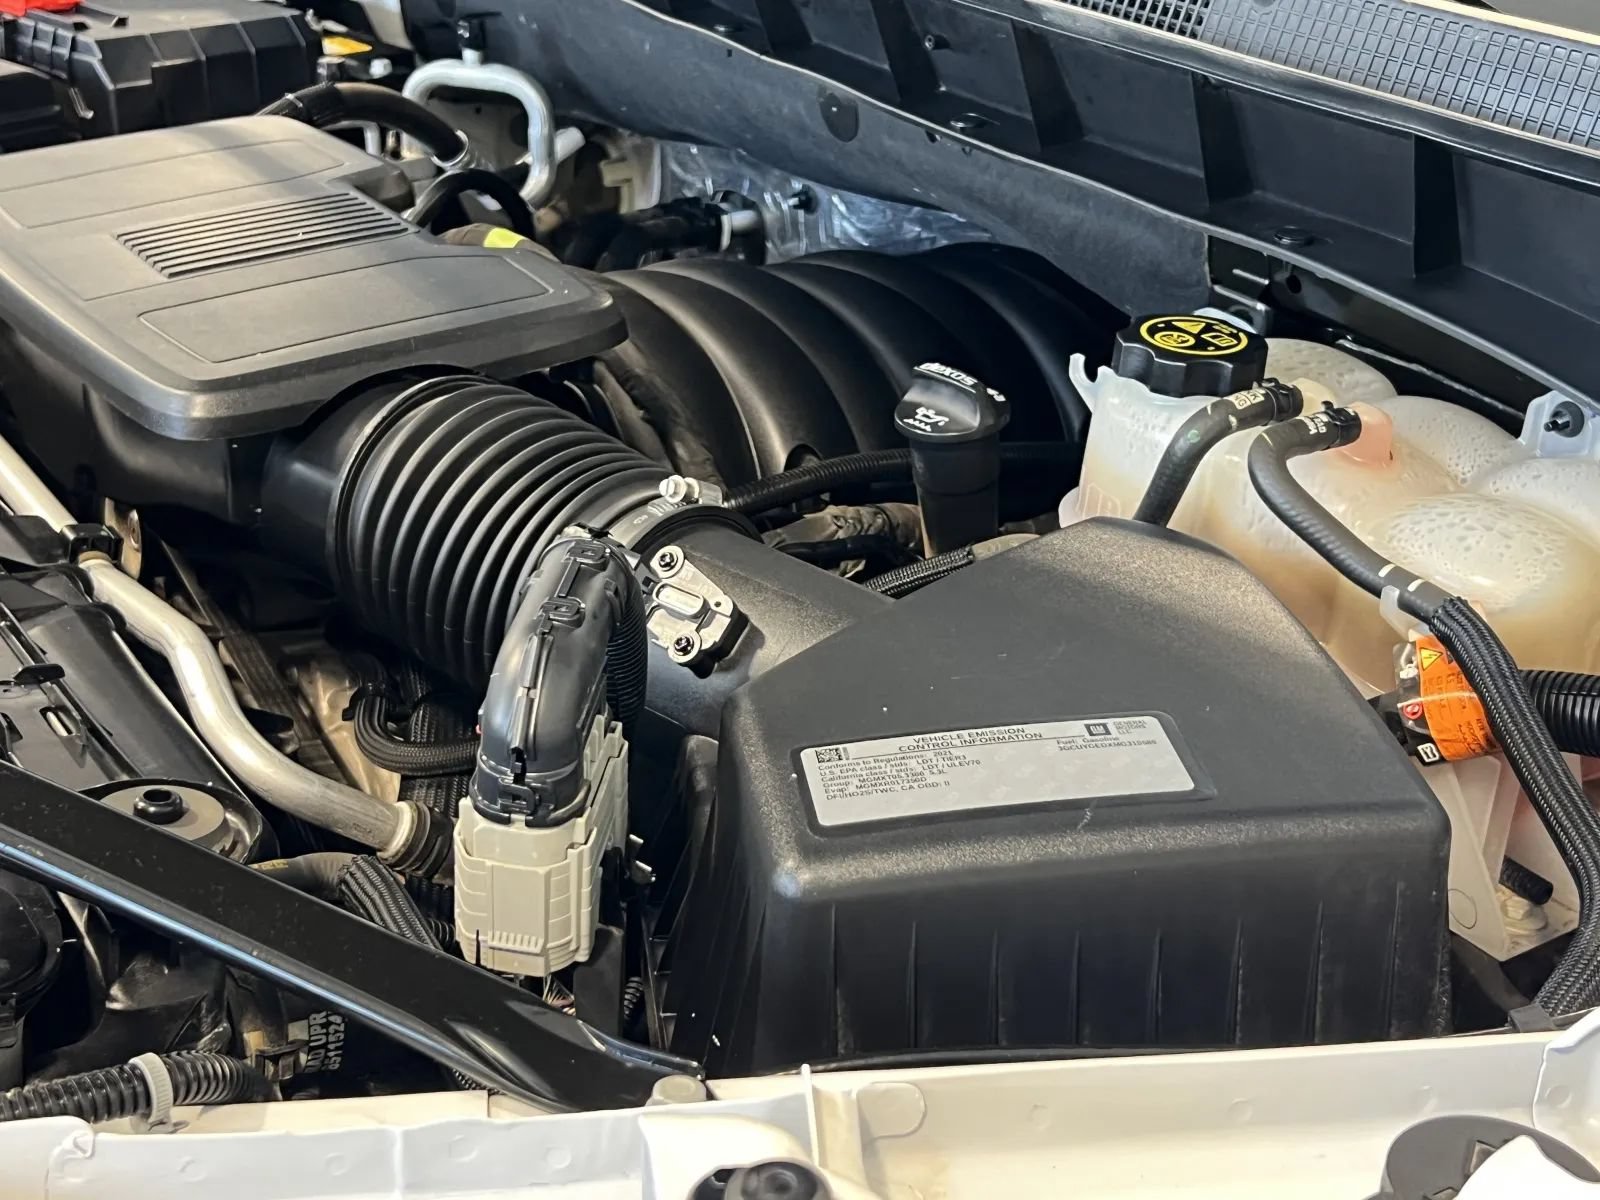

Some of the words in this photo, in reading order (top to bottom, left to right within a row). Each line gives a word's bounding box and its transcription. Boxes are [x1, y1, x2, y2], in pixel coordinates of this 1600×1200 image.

[919, 362, 978, 386] dexos
[898, 741, 955, 752] CONTROL
[960, 732, 1043, 745] INFORMATION
[913, 733, 965, 744] VEHICLE
[968, 728, 1026, 739] EMISSION
[818, 761, 860, 771] Conforms
[933, 750, 953, 758] 2021
[840, 767, 858, 776] EPA
[860, 763, 882, 772] class
[916, 757, 935, 766] LDT
[821, 772, 864, 783] California
[866, 769, 888, 778] class
[922, 762, 942, 771] LDT
[946, 759, 981, 769] ULEV70
[901, 783, 916, 792] CA
[308, 1010, 328, 1047] UPR
